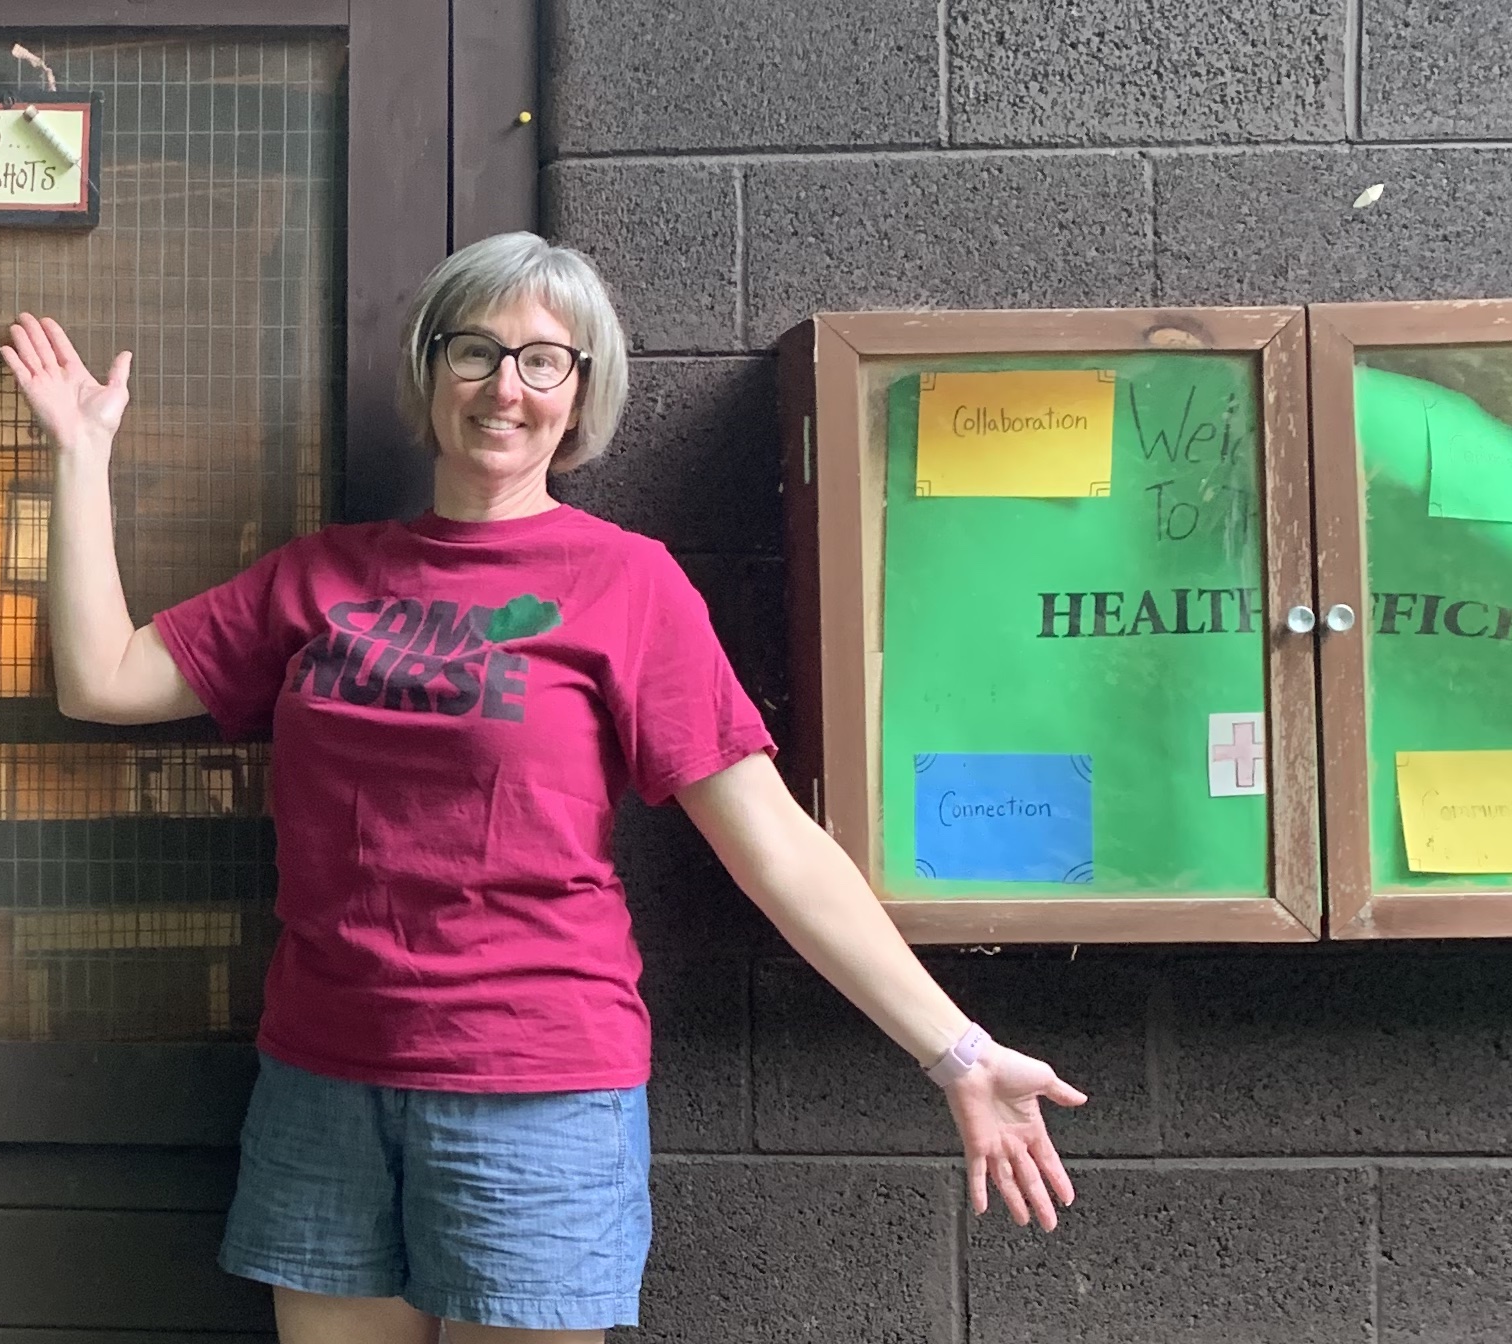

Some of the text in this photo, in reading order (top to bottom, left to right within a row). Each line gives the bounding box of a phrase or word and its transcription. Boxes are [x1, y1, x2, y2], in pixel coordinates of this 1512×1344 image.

[952, 404, 1088, 438] Collaboration
[1145, 480, 1200, 542] To
[290, 633, 529, 724] NURSE
[938, 790, 1053, 827] Connection
